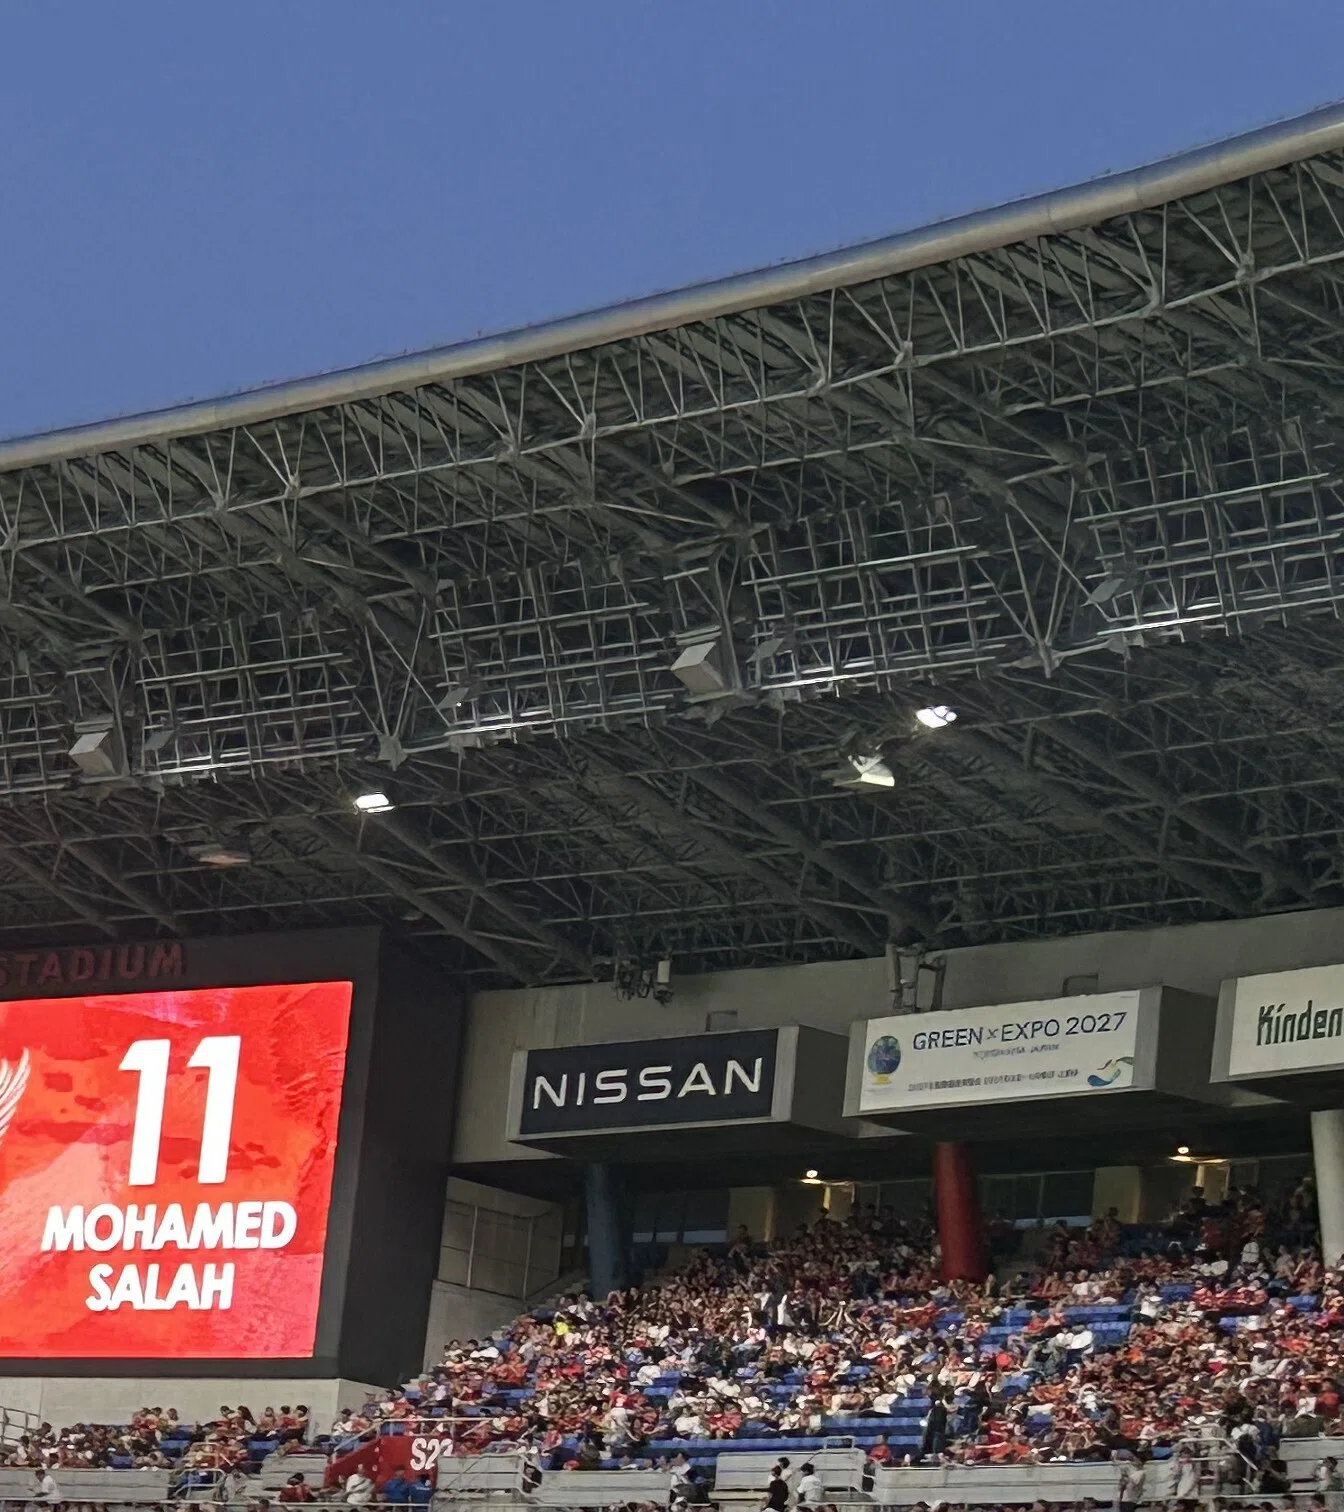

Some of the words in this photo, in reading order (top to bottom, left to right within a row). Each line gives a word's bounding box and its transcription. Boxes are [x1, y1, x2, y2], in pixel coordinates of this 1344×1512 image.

[1065, 1012, 1128, 1036] 2027
[531, 1057, 764, 1110] NISSAN
[119, 1035, 241, 1186] 11
[41, 1200, 297, 1252] MOHAMED
[86, 1262, 234, 1312] SALAH
